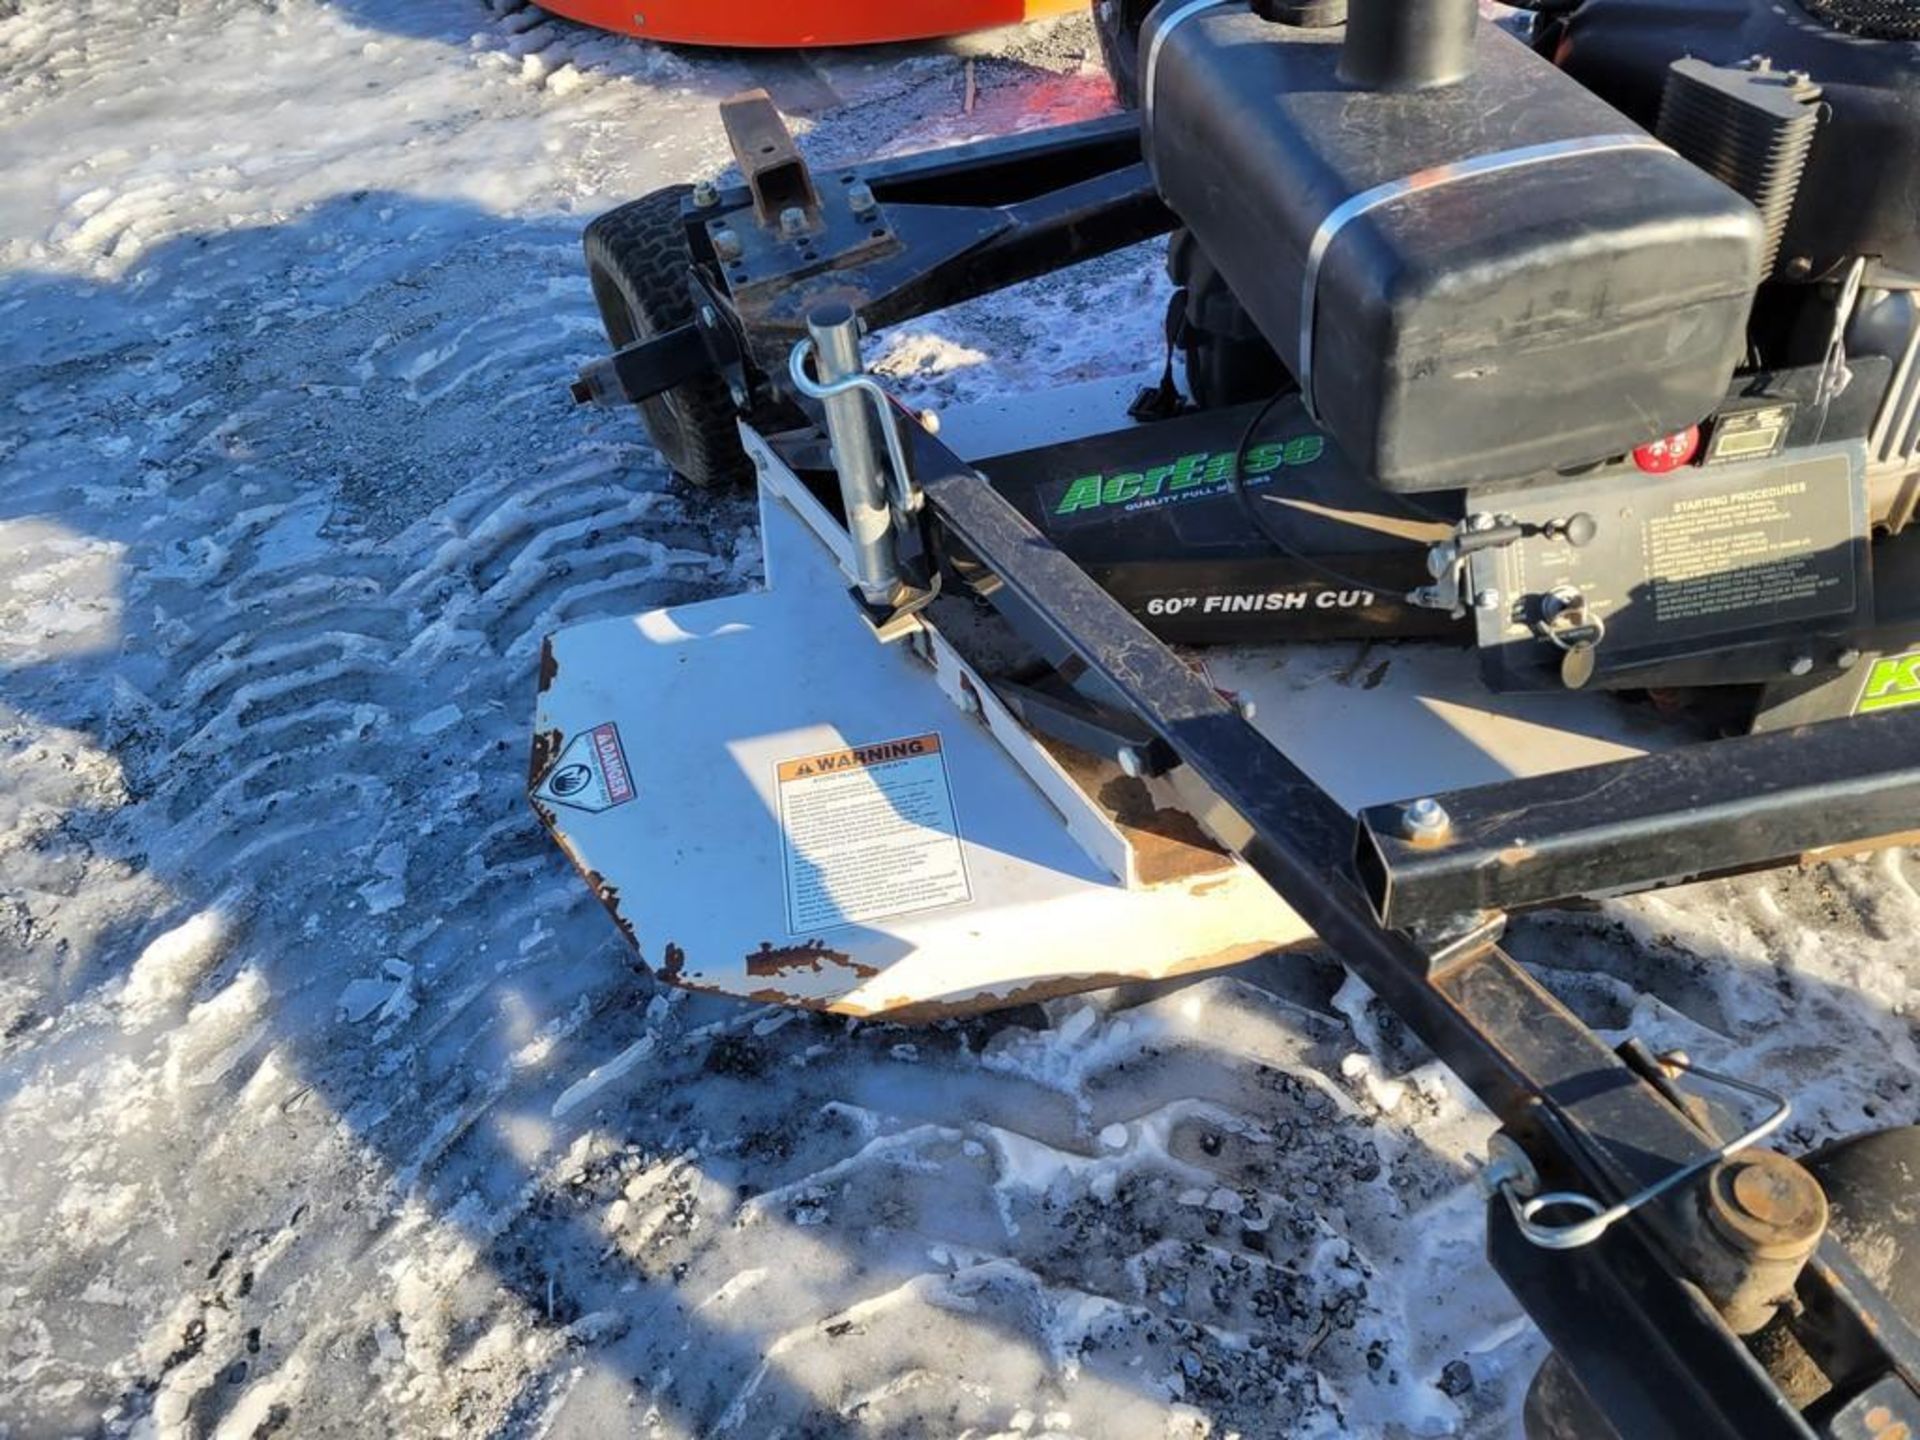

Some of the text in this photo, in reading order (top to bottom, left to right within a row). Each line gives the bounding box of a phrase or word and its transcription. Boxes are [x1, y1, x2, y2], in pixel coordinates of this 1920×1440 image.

[1124, 494, 1179, 511] QUALITY
[1181, 487, 1215, 500] PULL
[1673, 495, 1728, 513] STARTING
[1730, 481, 1806, 504] PROCEDURES
[1203, 592, 1308, 613] FINISH
[1315, 590, 1375, 609] CUT
[600, 744, 631, 798] DANGER
[816, 740, 924, 771] WARNING
